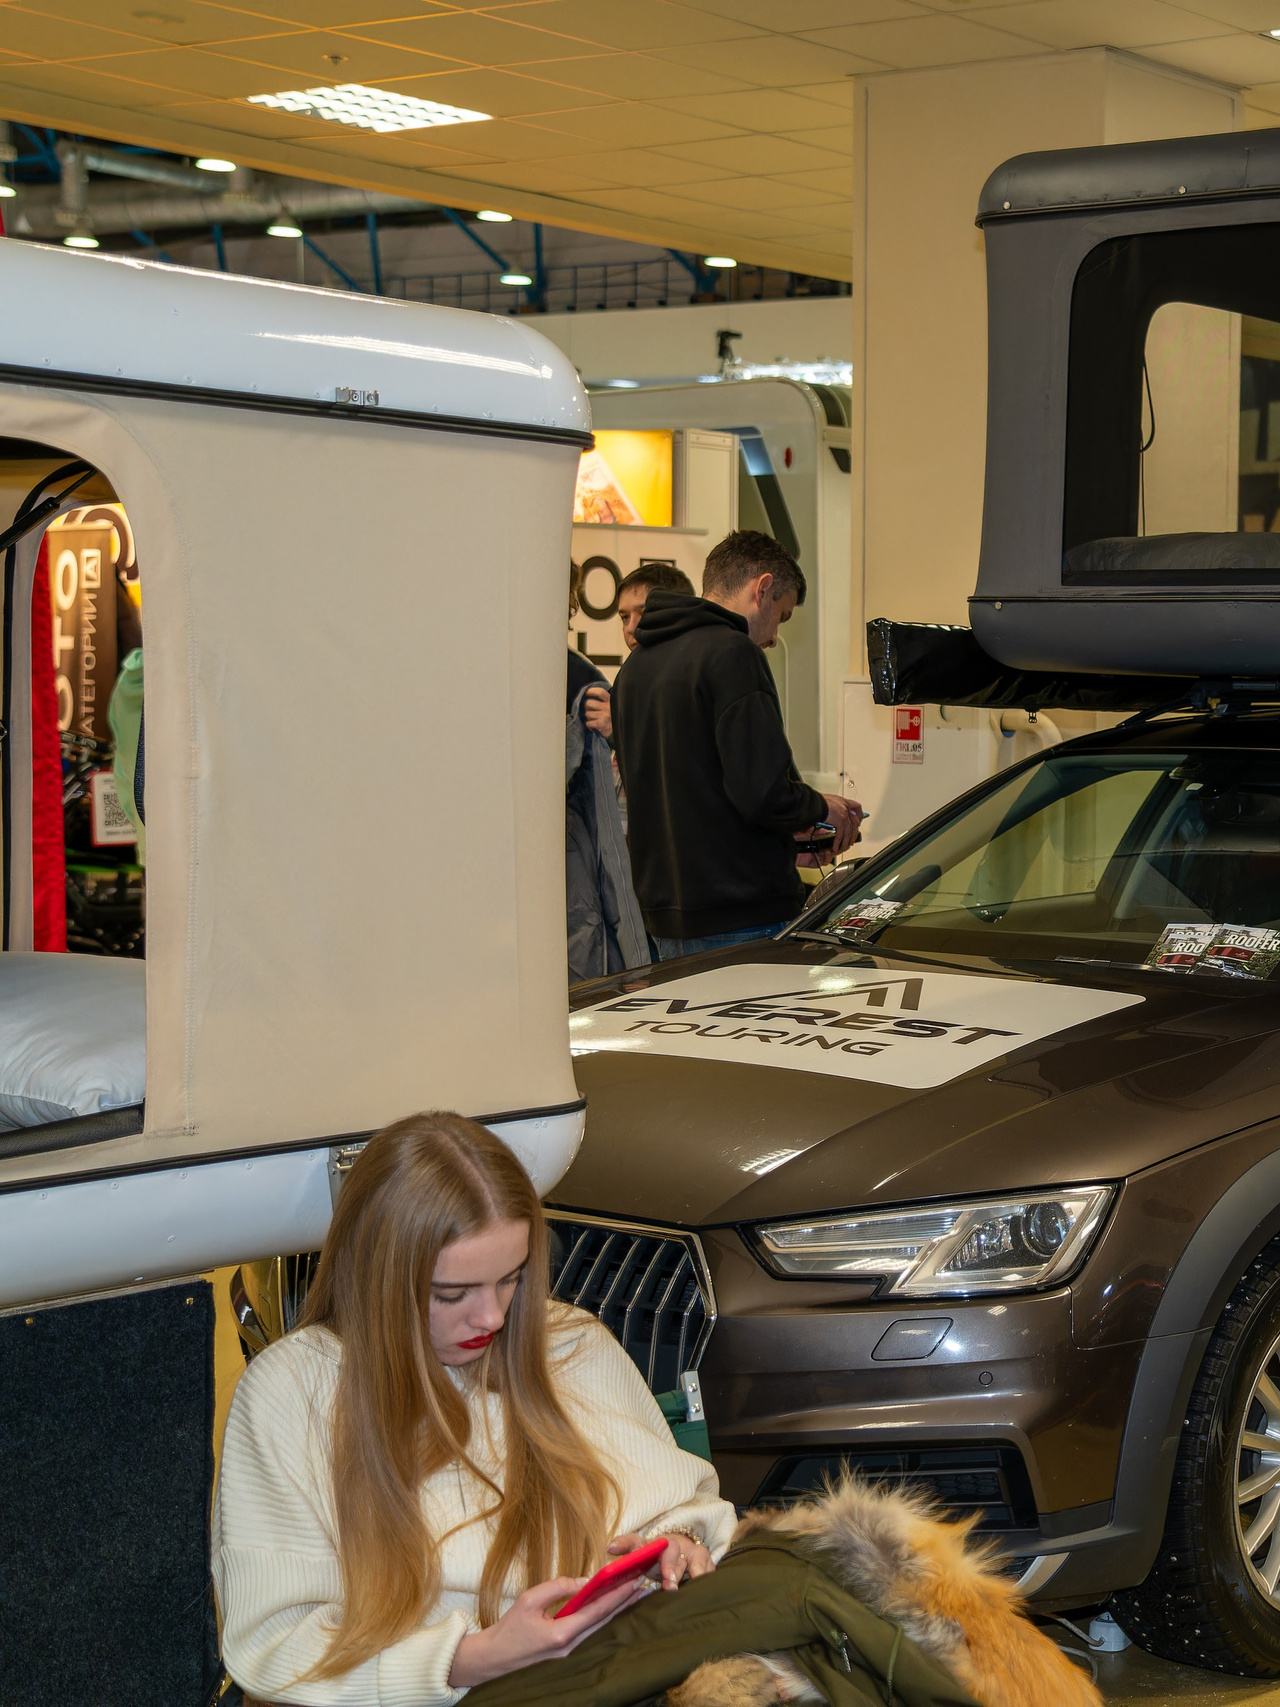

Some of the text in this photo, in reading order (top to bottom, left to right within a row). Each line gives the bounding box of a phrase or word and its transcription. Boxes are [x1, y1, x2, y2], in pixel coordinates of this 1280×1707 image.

[53, 549, 79, 732] ОТО
[79, 592, 98, 738] АТЕГОРИИ
[1173, 942, 1206, 953] ROO
[1225, 934, 1280, 951] ROOFER
[594, 993, 1024, 1046] EVEREST
[624, 1019, 896, 1057] TOURING
